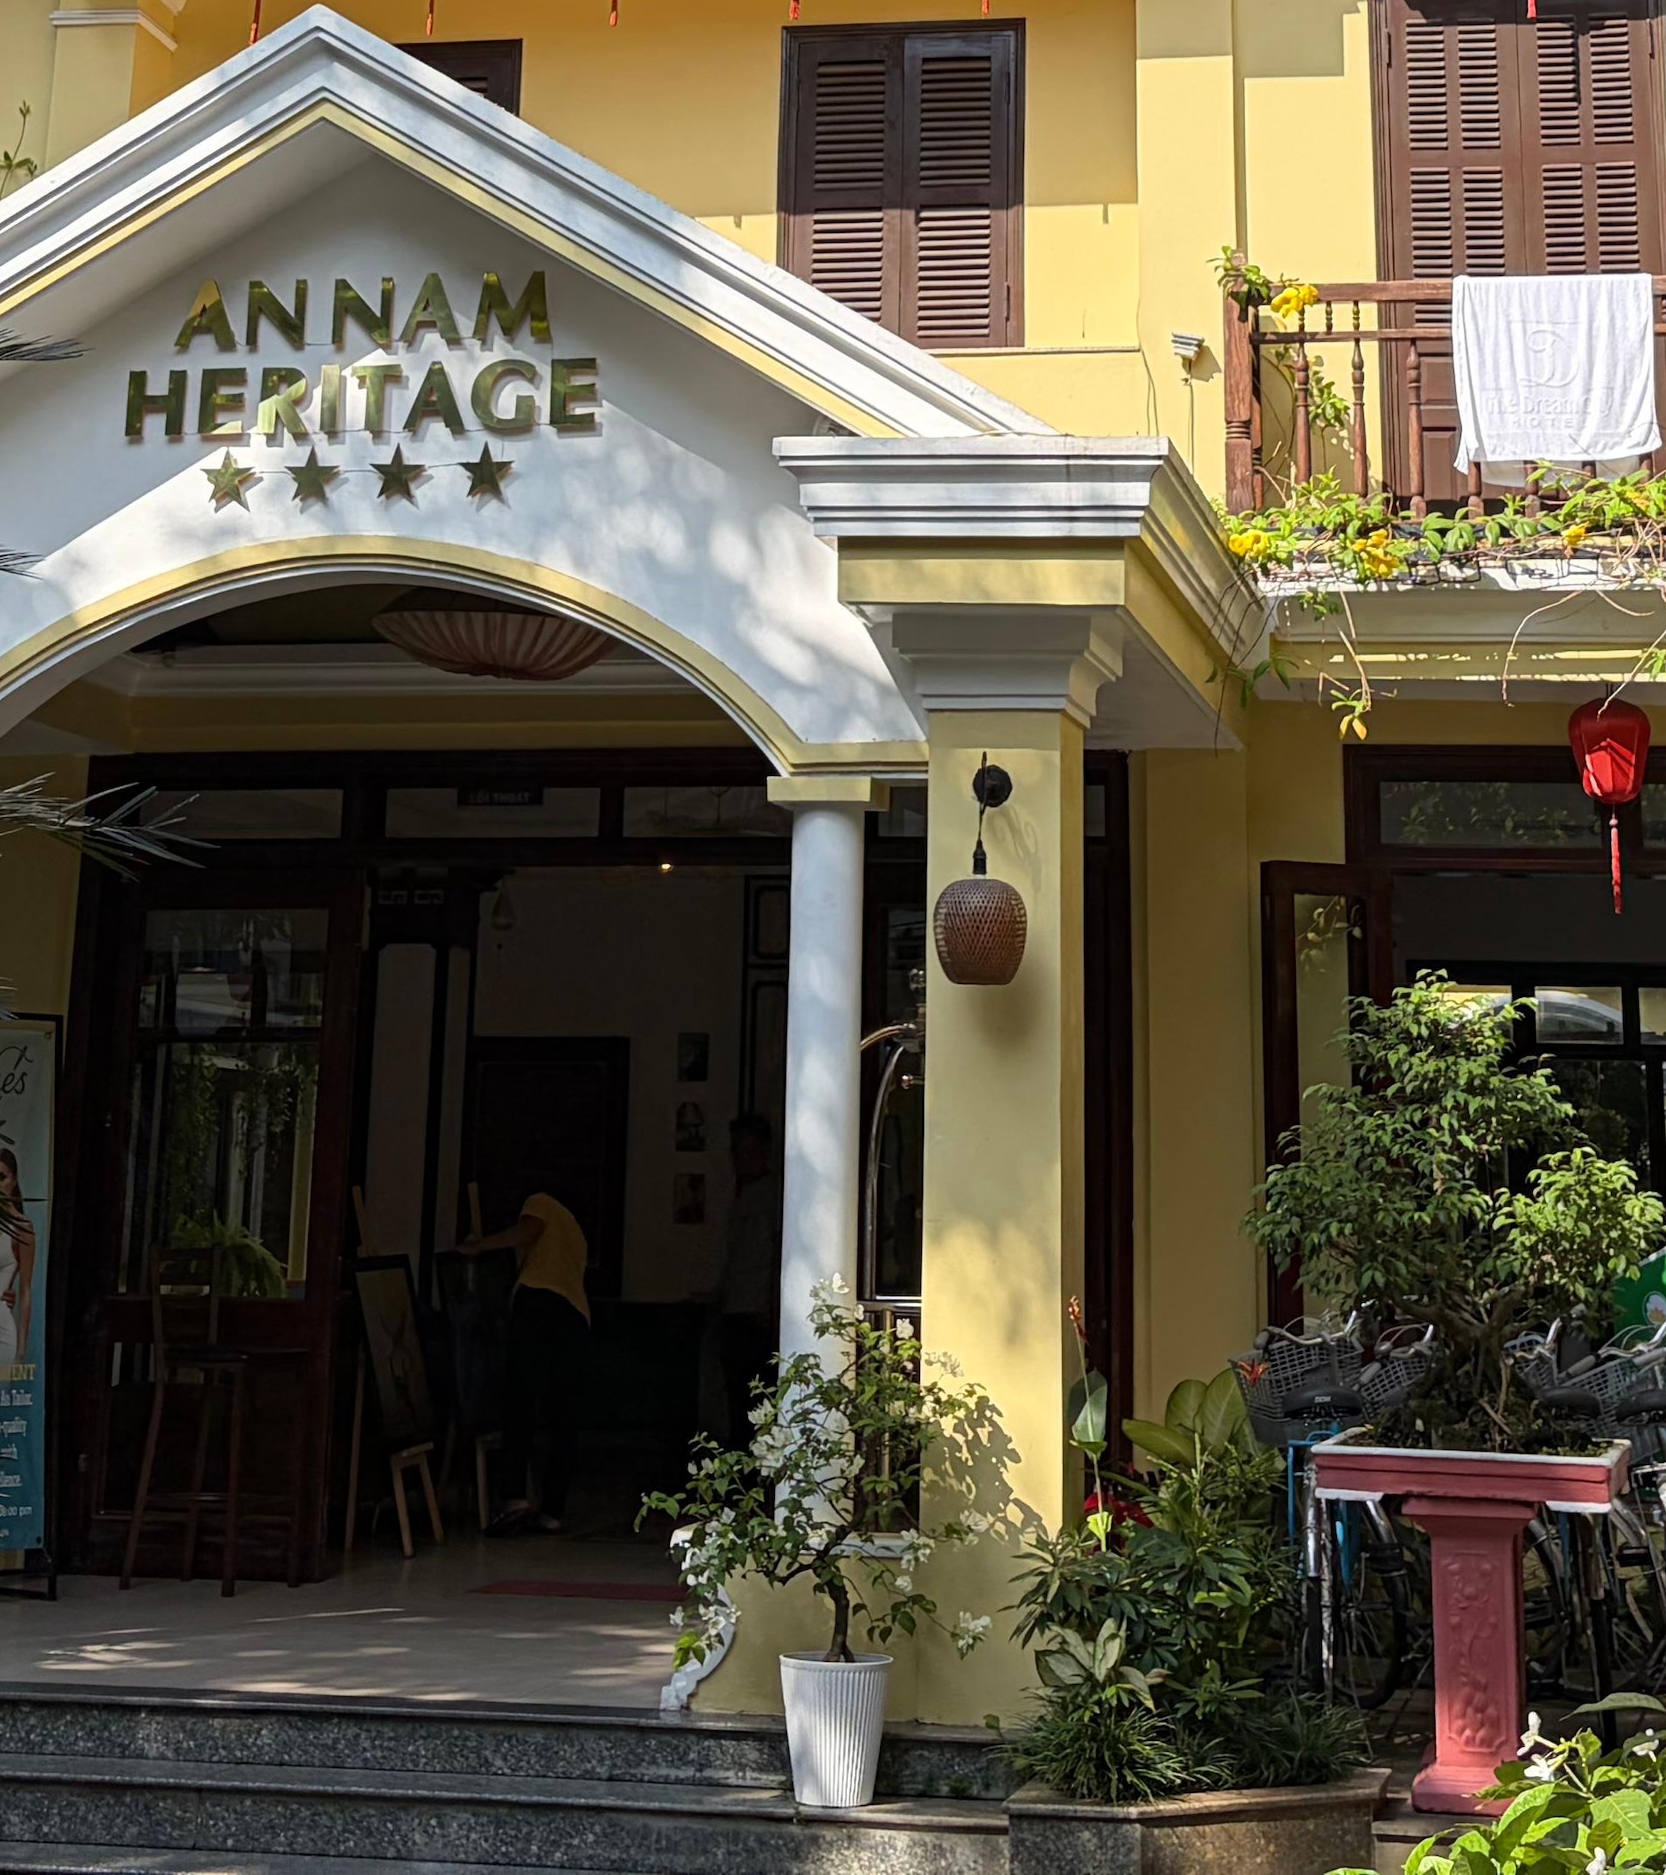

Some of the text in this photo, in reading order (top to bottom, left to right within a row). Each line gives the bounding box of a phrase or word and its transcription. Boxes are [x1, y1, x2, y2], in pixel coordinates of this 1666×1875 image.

[174, 270, 551, 351] ANNAM
[124, 358, 599, 437] HERITAGE
[1523, 392, 1577, 415] Dream
